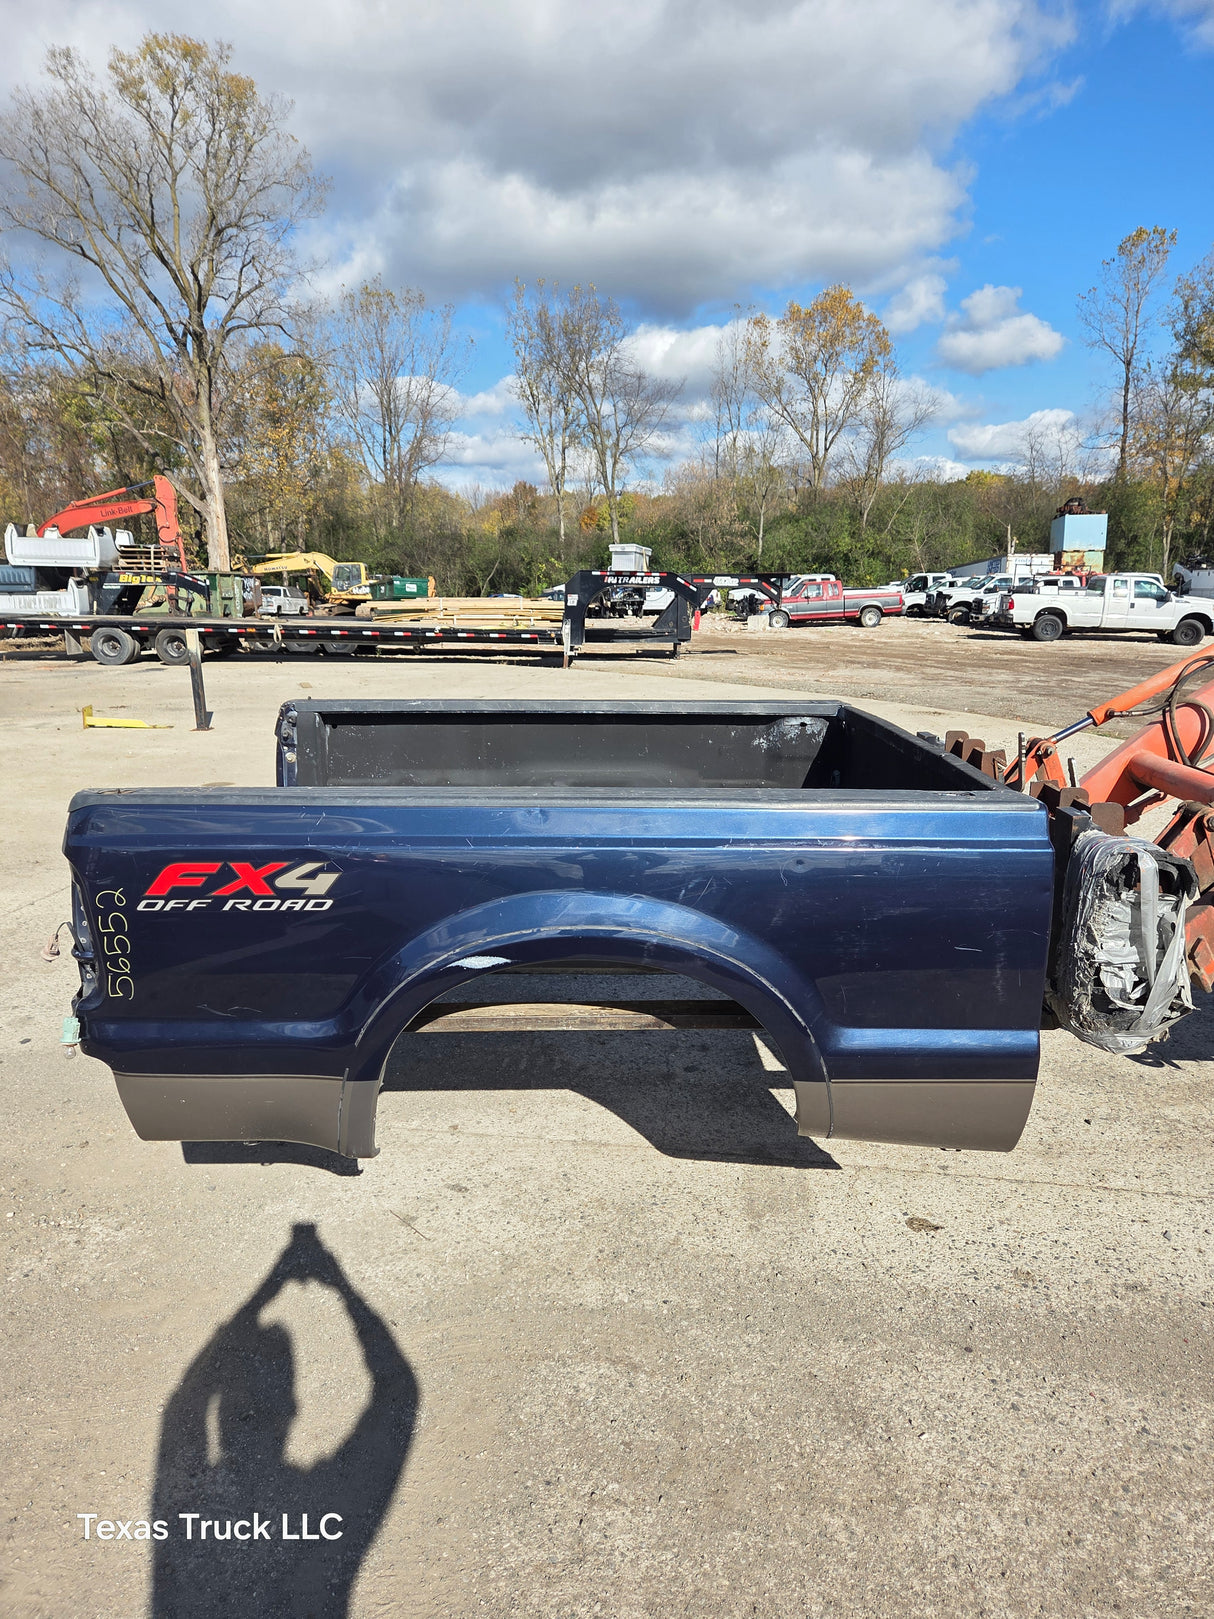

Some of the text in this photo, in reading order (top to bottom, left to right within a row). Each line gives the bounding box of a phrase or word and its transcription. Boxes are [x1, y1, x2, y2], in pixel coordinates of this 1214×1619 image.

[100, 506, 133, 518] Link-Belt
[143, 861, 343, 896] FX4
[136, 898, 334, 912] OFF ROAD
[95, 887, 135, 1001] 56552
